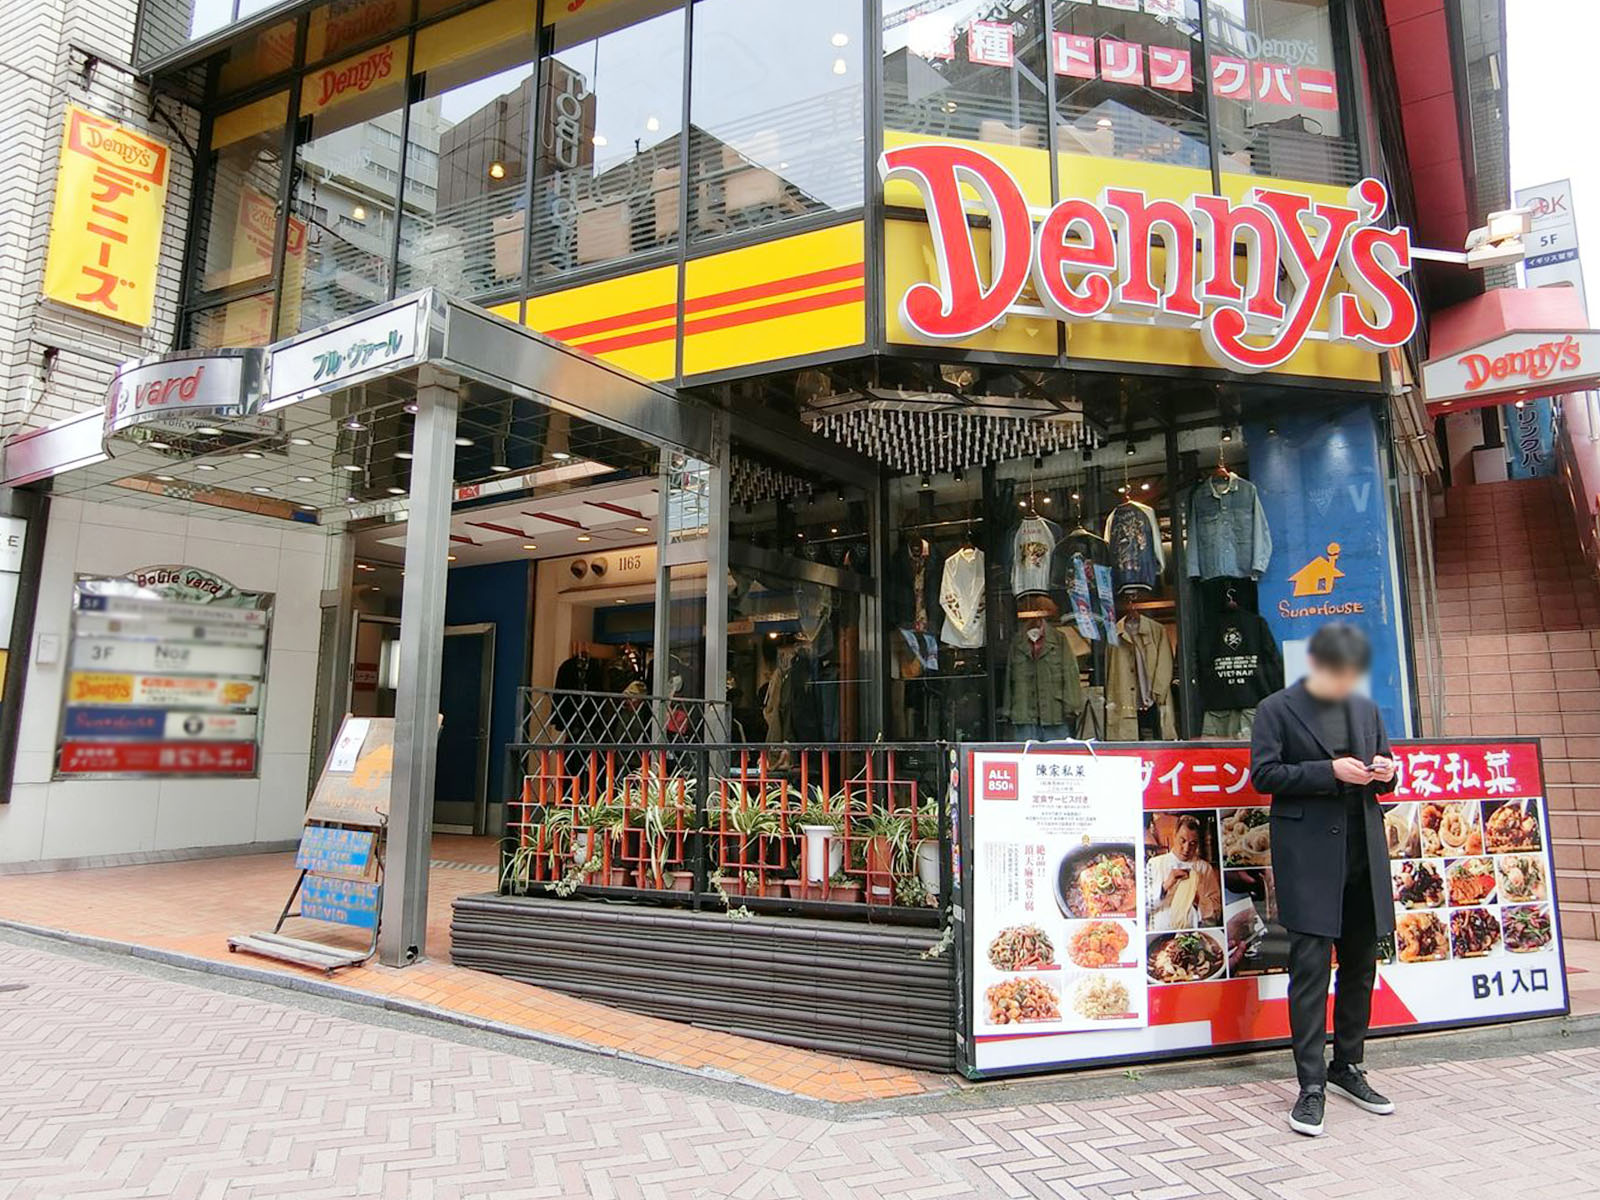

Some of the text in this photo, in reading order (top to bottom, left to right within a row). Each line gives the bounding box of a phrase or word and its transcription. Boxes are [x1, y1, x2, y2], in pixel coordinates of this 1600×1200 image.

[1244, 31, 1318, 66] Denny's
[318, 45, 393, 107] Denny's
[87, 127, 151, 168] Denny's
[76, 166, 150, 311] デニーズ
[1540, 233, 1558, 247] 5F
[878, 142, 1419, 373] Denny's
[1457, 335, 1582, 391] Denny's
[134, 365, 204, 409] vard
[619, 555, 641, 571] 1163
[137, 571, 223, 594] Boule vard
[988, 769, 1012, 780] ALL
[1035, 763, 1086, 777] 陳家私菜
[1472, 968, 1549, 999] B1 入口
